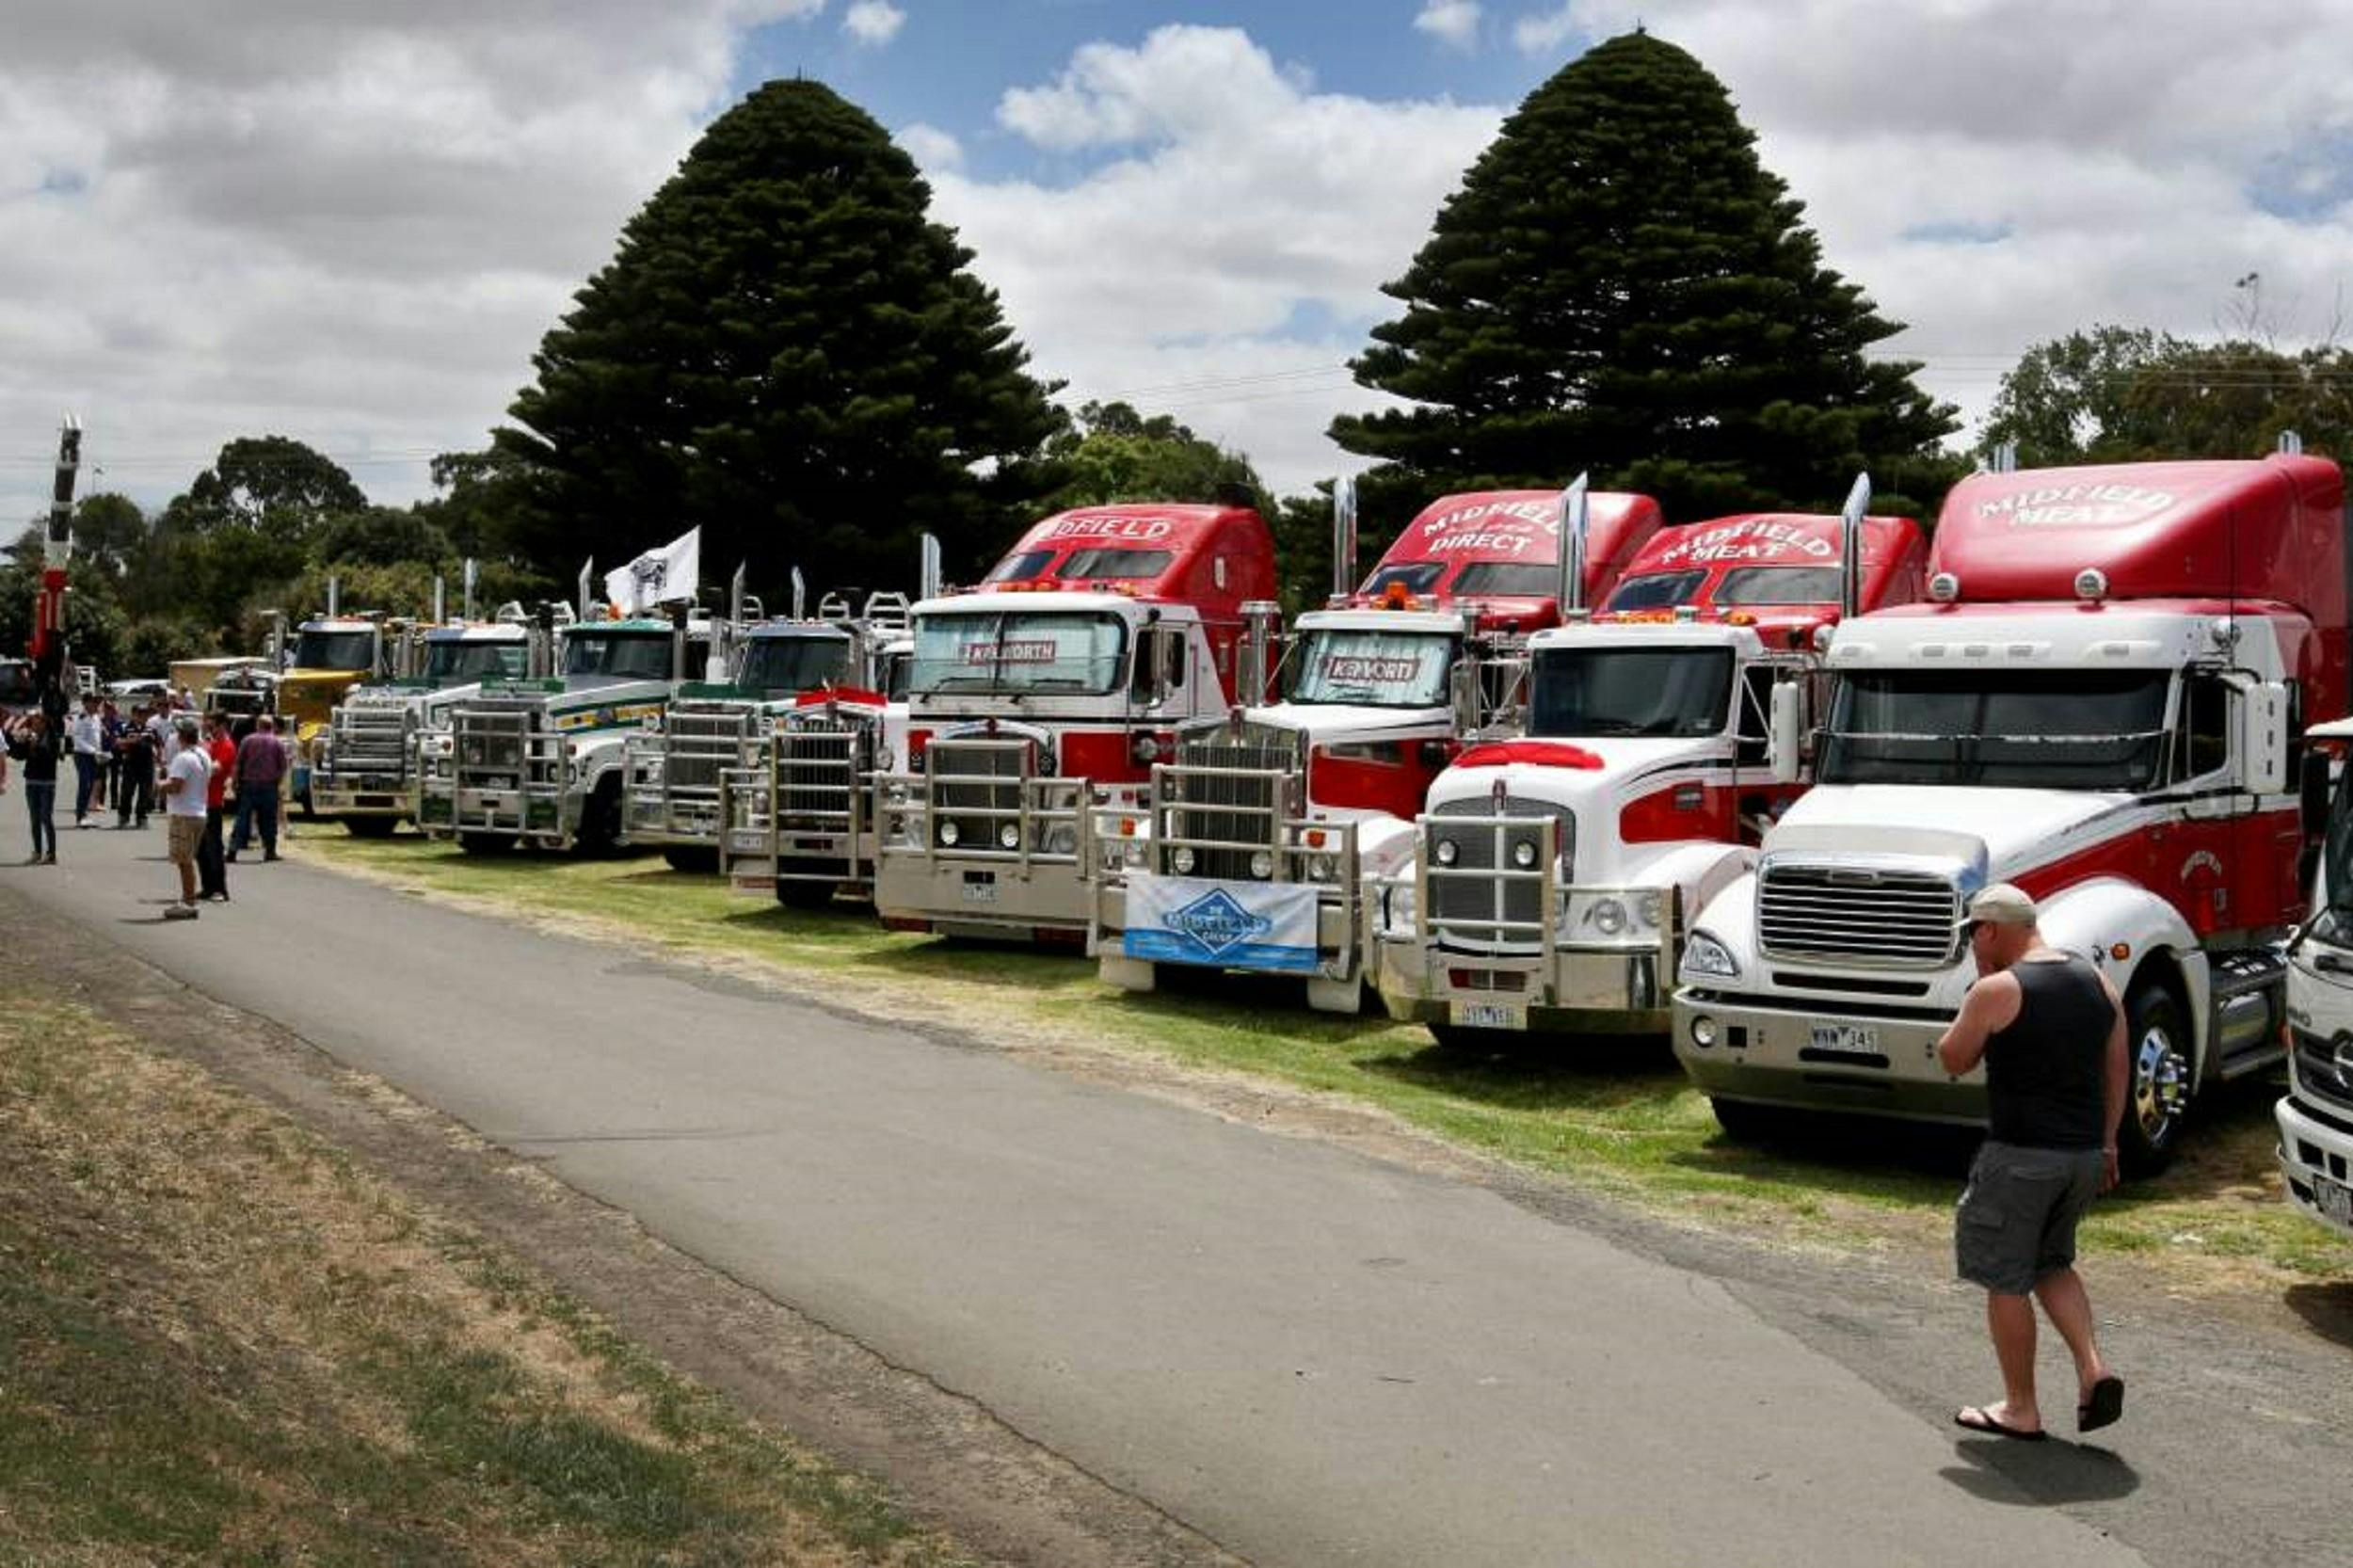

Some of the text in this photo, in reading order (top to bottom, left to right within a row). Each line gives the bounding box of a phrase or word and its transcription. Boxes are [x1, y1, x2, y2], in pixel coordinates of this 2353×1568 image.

[1979, 484, 2174, 520] MIDFIELD
[1429, 533, 1533, 554] DIRECT
[1661, 520, 1832, 565] MIDFIELD
[1689, 543, 1786, 562] MEAT
